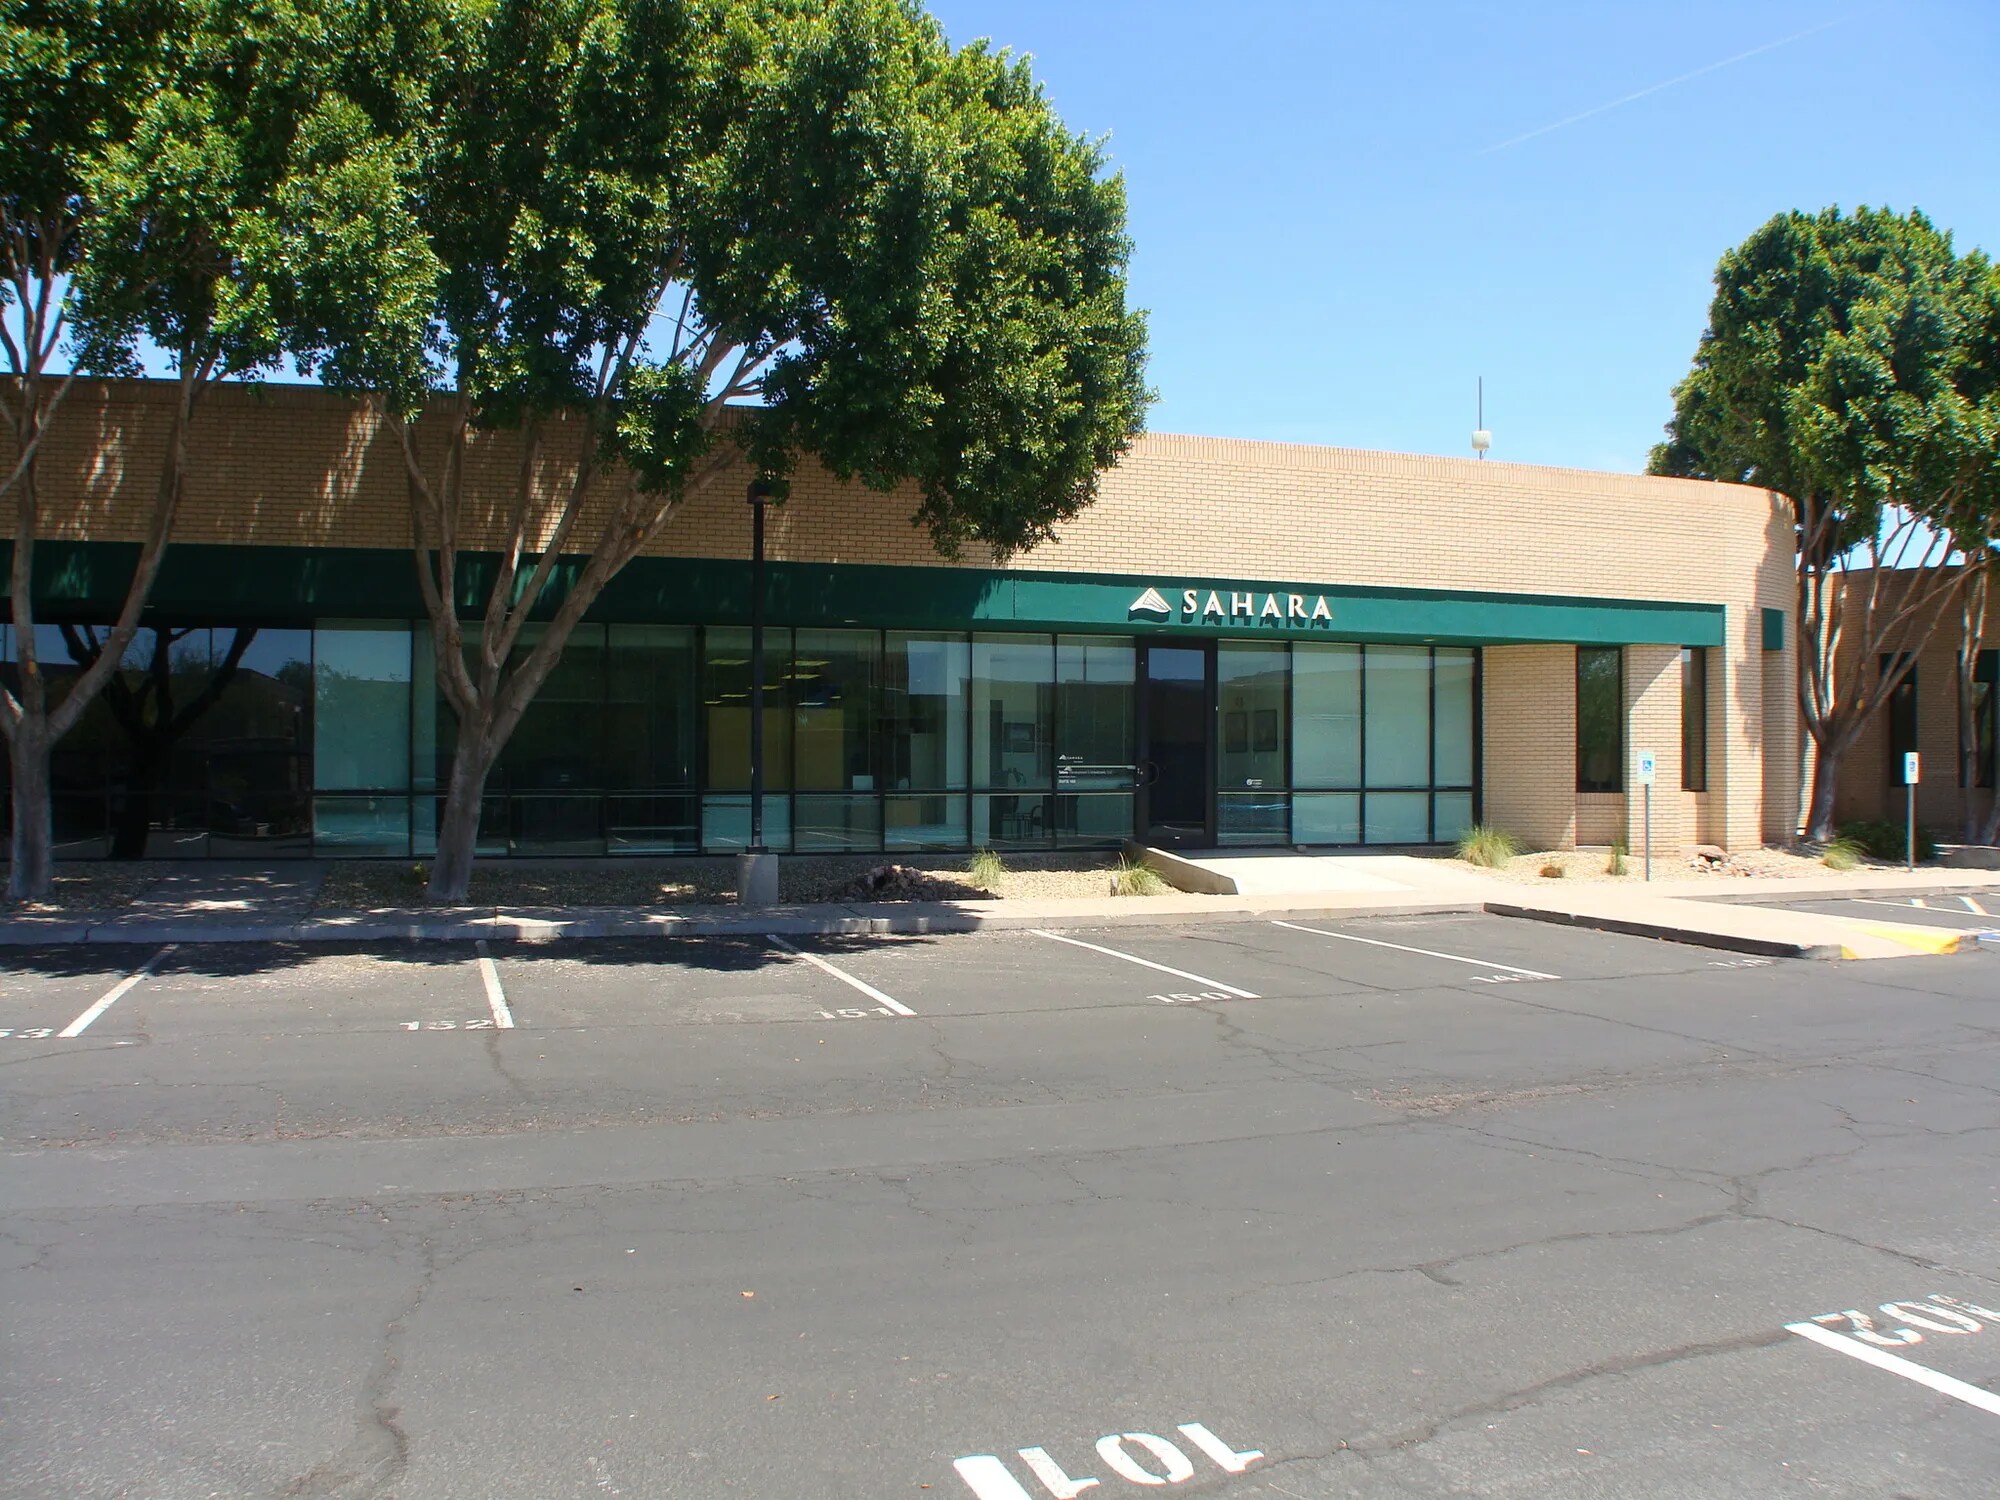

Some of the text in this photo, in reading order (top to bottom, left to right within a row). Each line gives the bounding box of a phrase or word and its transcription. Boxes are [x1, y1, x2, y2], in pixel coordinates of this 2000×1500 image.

[1182, 589, 1333, 620] SAHARA
[1146, 991, 1232, 1003] 150
[814, 1007, 895, 1019] 151
[399, 1018, 494, 1031] 152
[1016, 1421, 1265, 1500] 101
